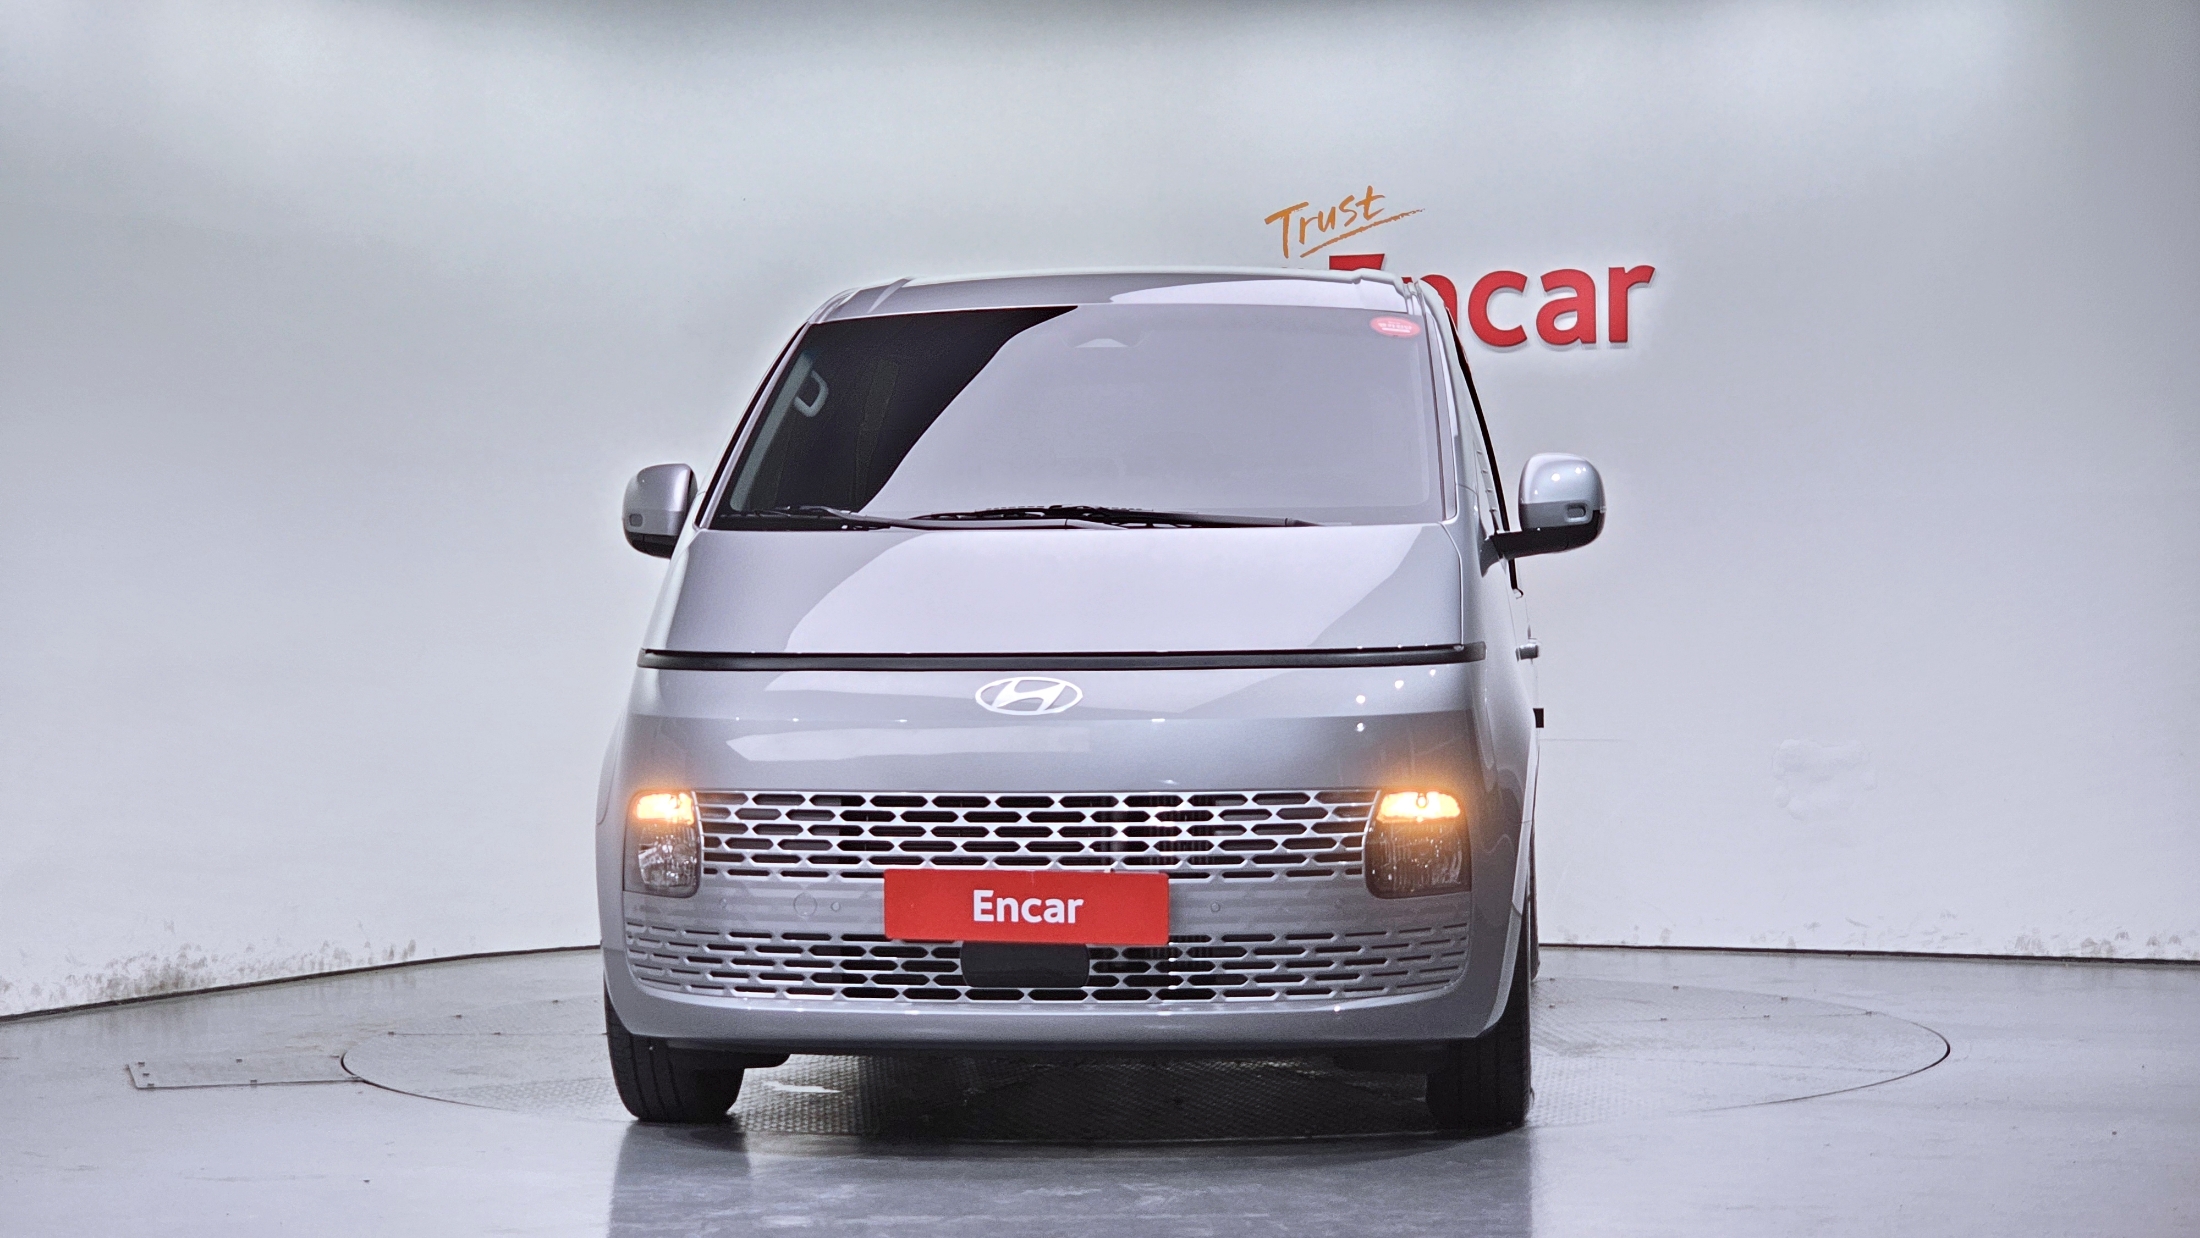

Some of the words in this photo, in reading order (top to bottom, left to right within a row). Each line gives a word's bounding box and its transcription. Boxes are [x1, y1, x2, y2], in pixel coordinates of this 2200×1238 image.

[1264, 185, 1386, 259] Trust
[1328, 253, 1655, 347] car
[973, 889, 1084, 924] Encar
